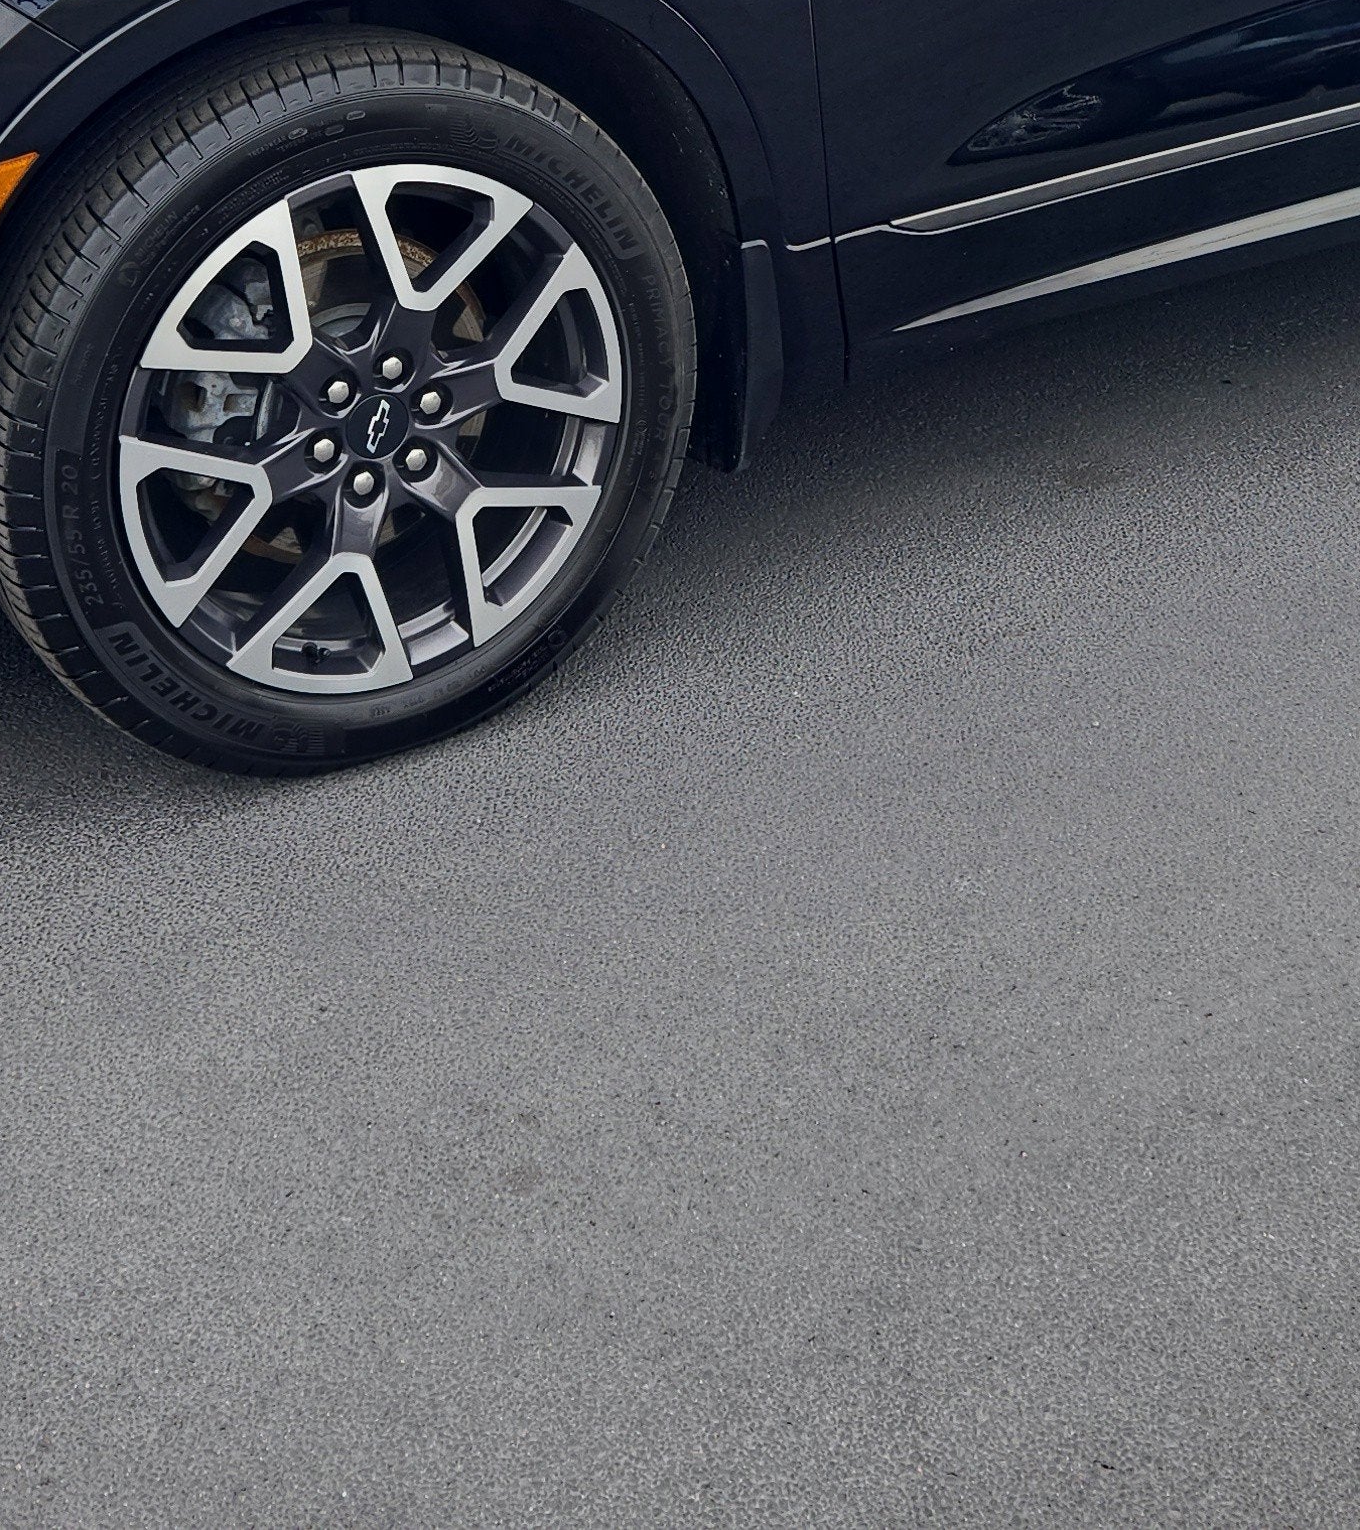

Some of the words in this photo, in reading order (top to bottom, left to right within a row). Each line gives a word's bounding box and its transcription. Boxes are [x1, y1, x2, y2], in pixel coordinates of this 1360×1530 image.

[501, 127, 640, 254] MICHELIN
[60, 462, 79, 498] 20
[61, 499, 81, 524] R
[64, 524, 105, 612] 235/55
[106, 623, 266, 743] MICHELIN
